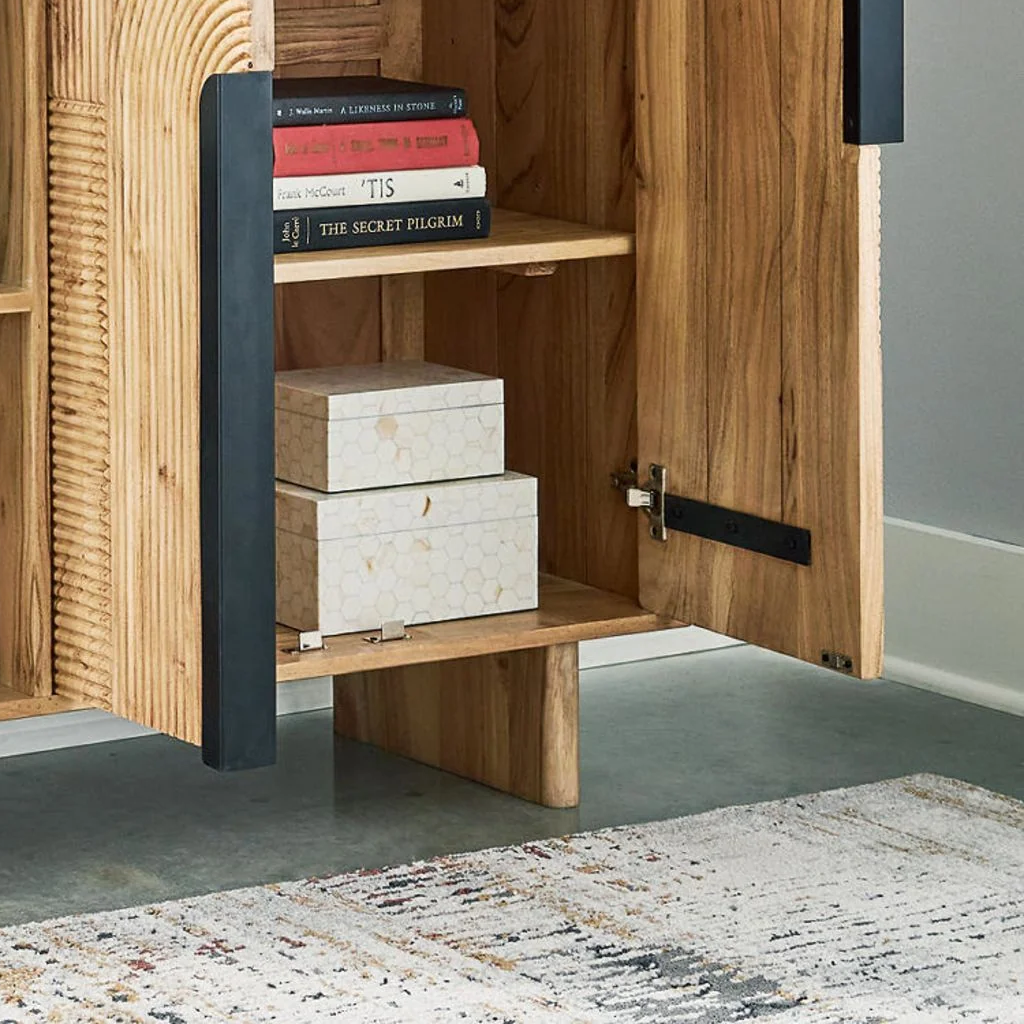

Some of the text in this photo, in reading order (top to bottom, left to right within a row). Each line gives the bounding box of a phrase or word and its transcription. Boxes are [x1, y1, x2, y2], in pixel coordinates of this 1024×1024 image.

[340, 102, 437, 114] A LIKENESS IN STONE
[304, 186, 346, 198] McCourt
[361, 178, 395, 199] 'TIS
[281, 222, 291, 243] John
[319, 222, 349, 237] THE
[351, 218, 405, 235] SECRET
[406, 214, 464, 231] PILGRIM
